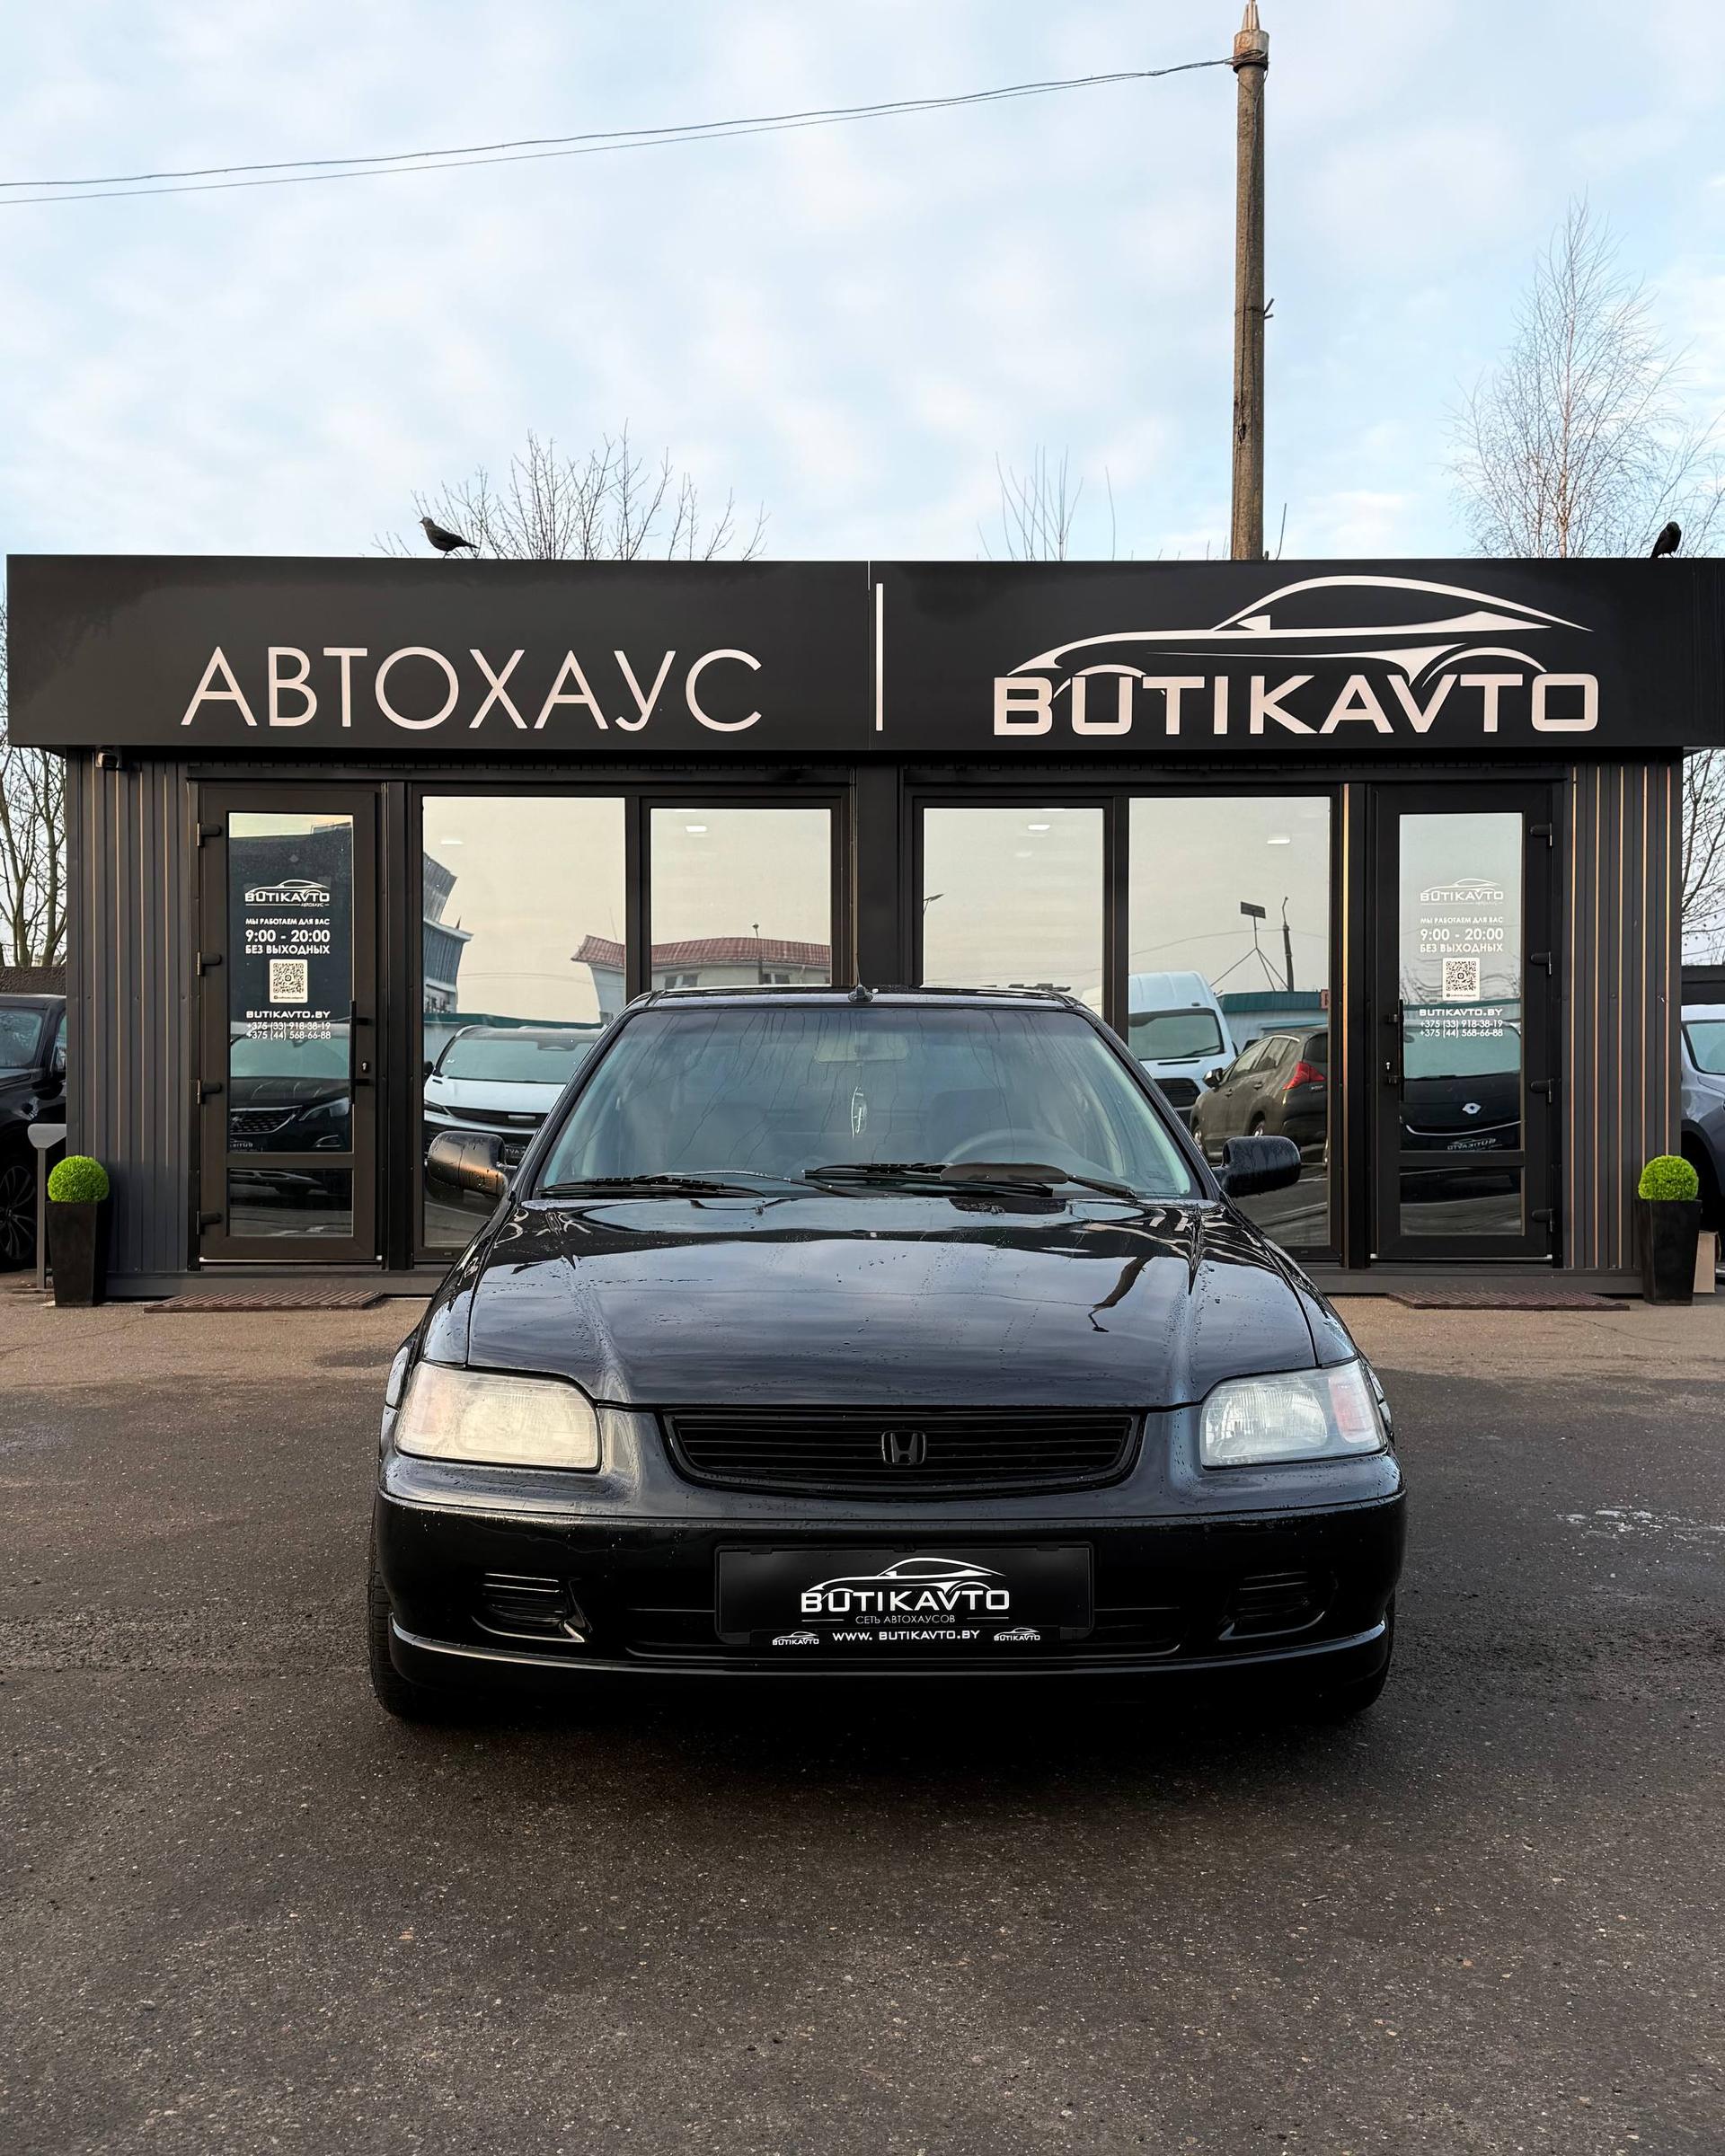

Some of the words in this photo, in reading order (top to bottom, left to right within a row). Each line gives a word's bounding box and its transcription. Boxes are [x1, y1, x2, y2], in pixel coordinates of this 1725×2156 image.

[181, 645, 762, 733] АВТОХАУС
[994, 673, 1599, 736] BUTIKAVTO
[244, 891, 331, 902] BUTIKAVTO
[1420, 890, 1504, 902] BUTIKAVTO
[298, 918, 314, 926] ДЛЯ
[245, 929, 277, 942] 9:00
[290, 929, 331, 942] 20:00
[1420, 928, 1450, 941] 9:00
[1464, 928, 1504, 941] 20:00
[245, 944, 263, 954] БЕЗ
[266, 944, 331, 955] ВЫХОДНЫХ
[1420, 943, 1438, 952] БЕЗ
[1439, 942, 1503, 953] ВЫХОДНЫХ
[246, 1011, 331, 1019] BUTIKAVTO.BY
[1419, 1008, 1503, 1017] BUTIKAVTO.BY
[246, 1021, 268, 1030] +375
[270, 1021, 287, 1032] (33)
[288, 1021, 331, 1030] 918-38-19
[1420, 1020, 1441, 1028] +375
[1443, 1020, 1459, 1029] (33)
[1461, 1020, 1503, 1028] 918-38-19
[246, 1030, 268, 1039] +375
[270, 1030, 287, 1040] (44)
[288, 1030, 332, 1039] 568-66-88
[1420, 1029, 1441, 1037] +375
[1443, 1029, 1459, 1038] (44)
[1461, 1029, 1503, 1037] 568-66-88
[801, 1590, 1010, 1613] BUTIKAVTO
[855, 1616, 880, 1625] СЕТЬ
[883, 1614, 956, 1624] АВТОХАУСОВ
[879, 1630, 980, 1641] BUTIKAVTO.BY
[994, 1633, 1041, 1642] BUTIKAVTO
[772, 1638, 819, 1646] BUTIKAVTO
